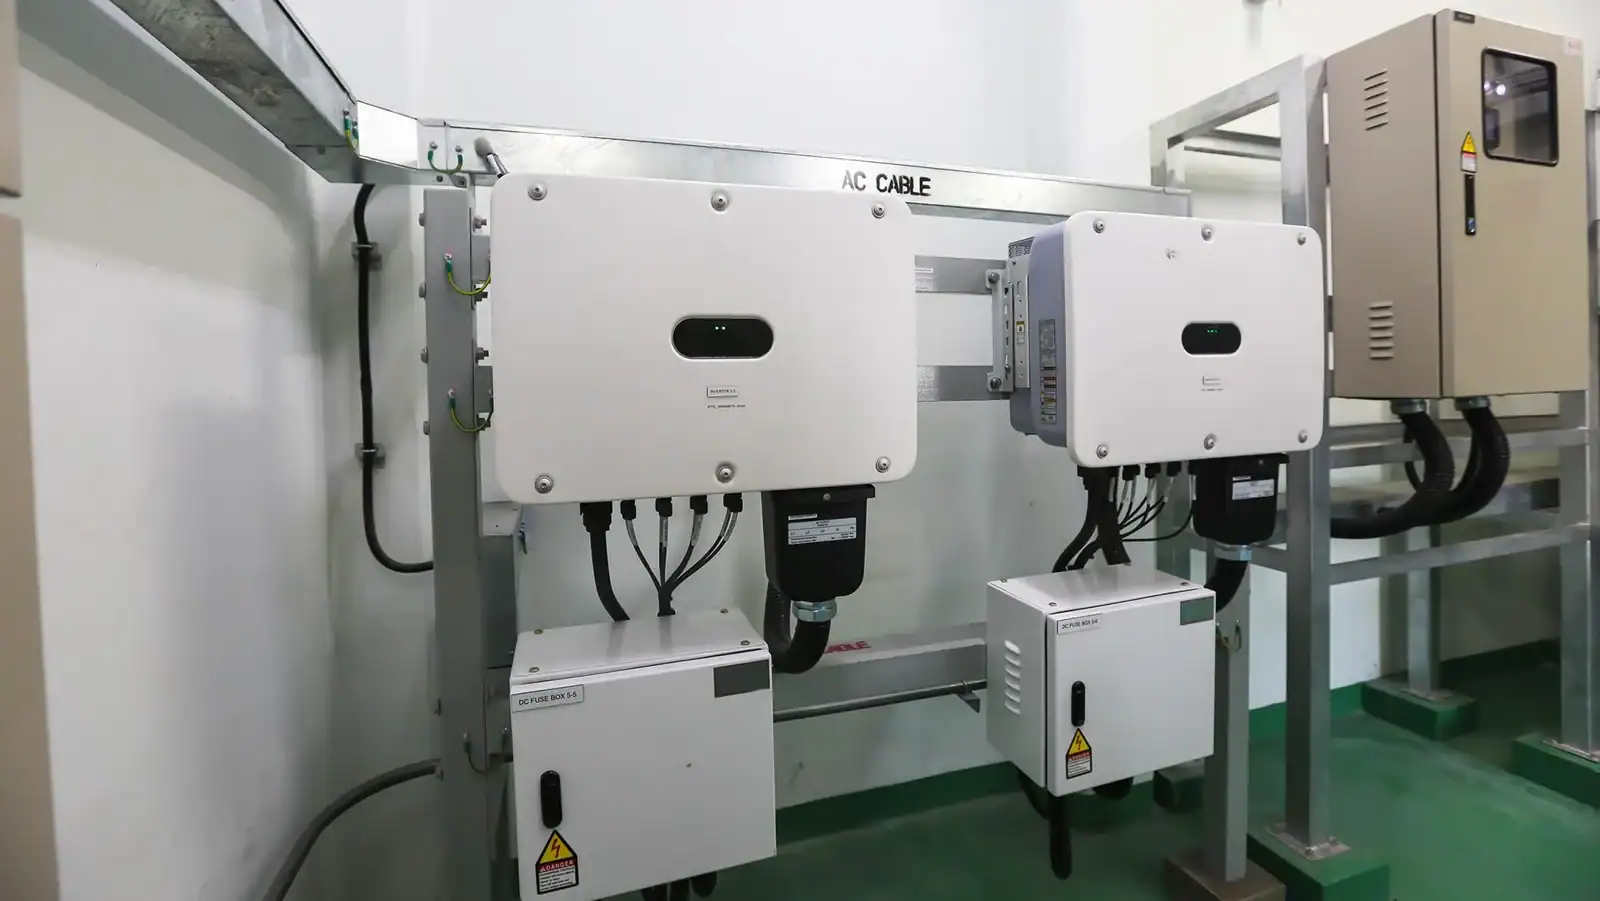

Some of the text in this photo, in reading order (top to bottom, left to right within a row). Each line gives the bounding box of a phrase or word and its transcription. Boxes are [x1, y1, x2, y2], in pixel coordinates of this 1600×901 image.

[841, 169, 932, 197] AC CABLE
[518, 691, 577, 706] DC FUSE BOX 5-5
[545, 859, 574, 870] DANGER
